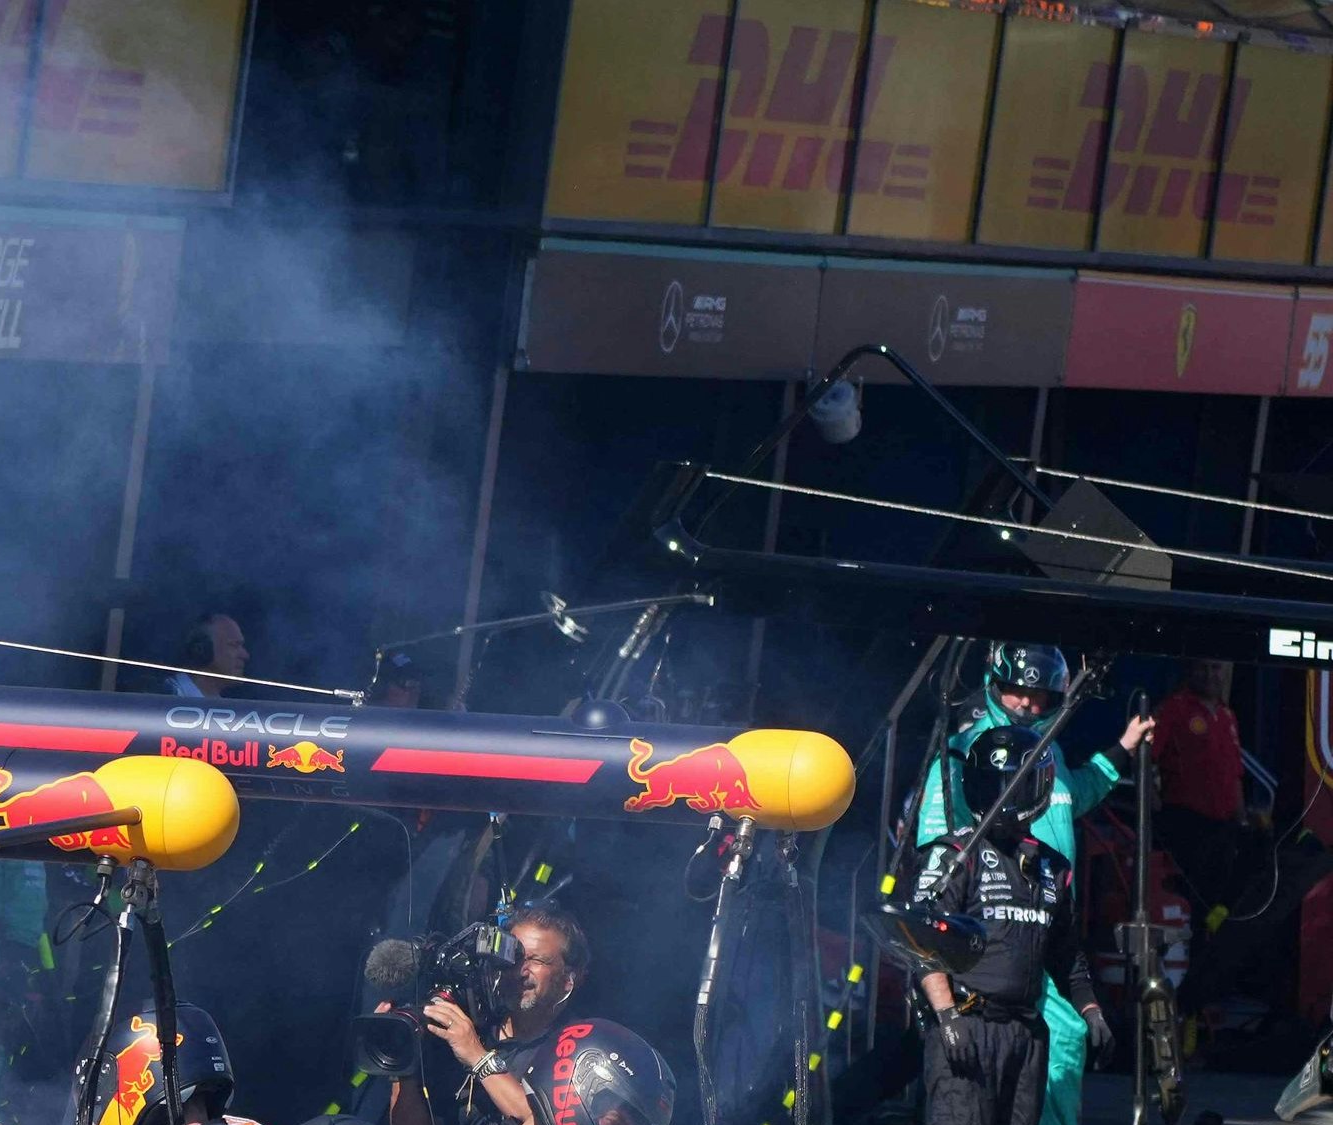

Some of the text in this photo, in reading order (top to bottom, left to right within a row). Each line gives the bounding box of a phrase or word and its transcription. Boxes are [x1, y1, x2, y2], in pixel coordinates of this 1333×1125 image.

[666, 14, 896, 194] DHL
[1061, 61, 1252, 226] DHL
[166, 706, 352, 738] ORACLE
[991, 872, 1007, 881] UBS
